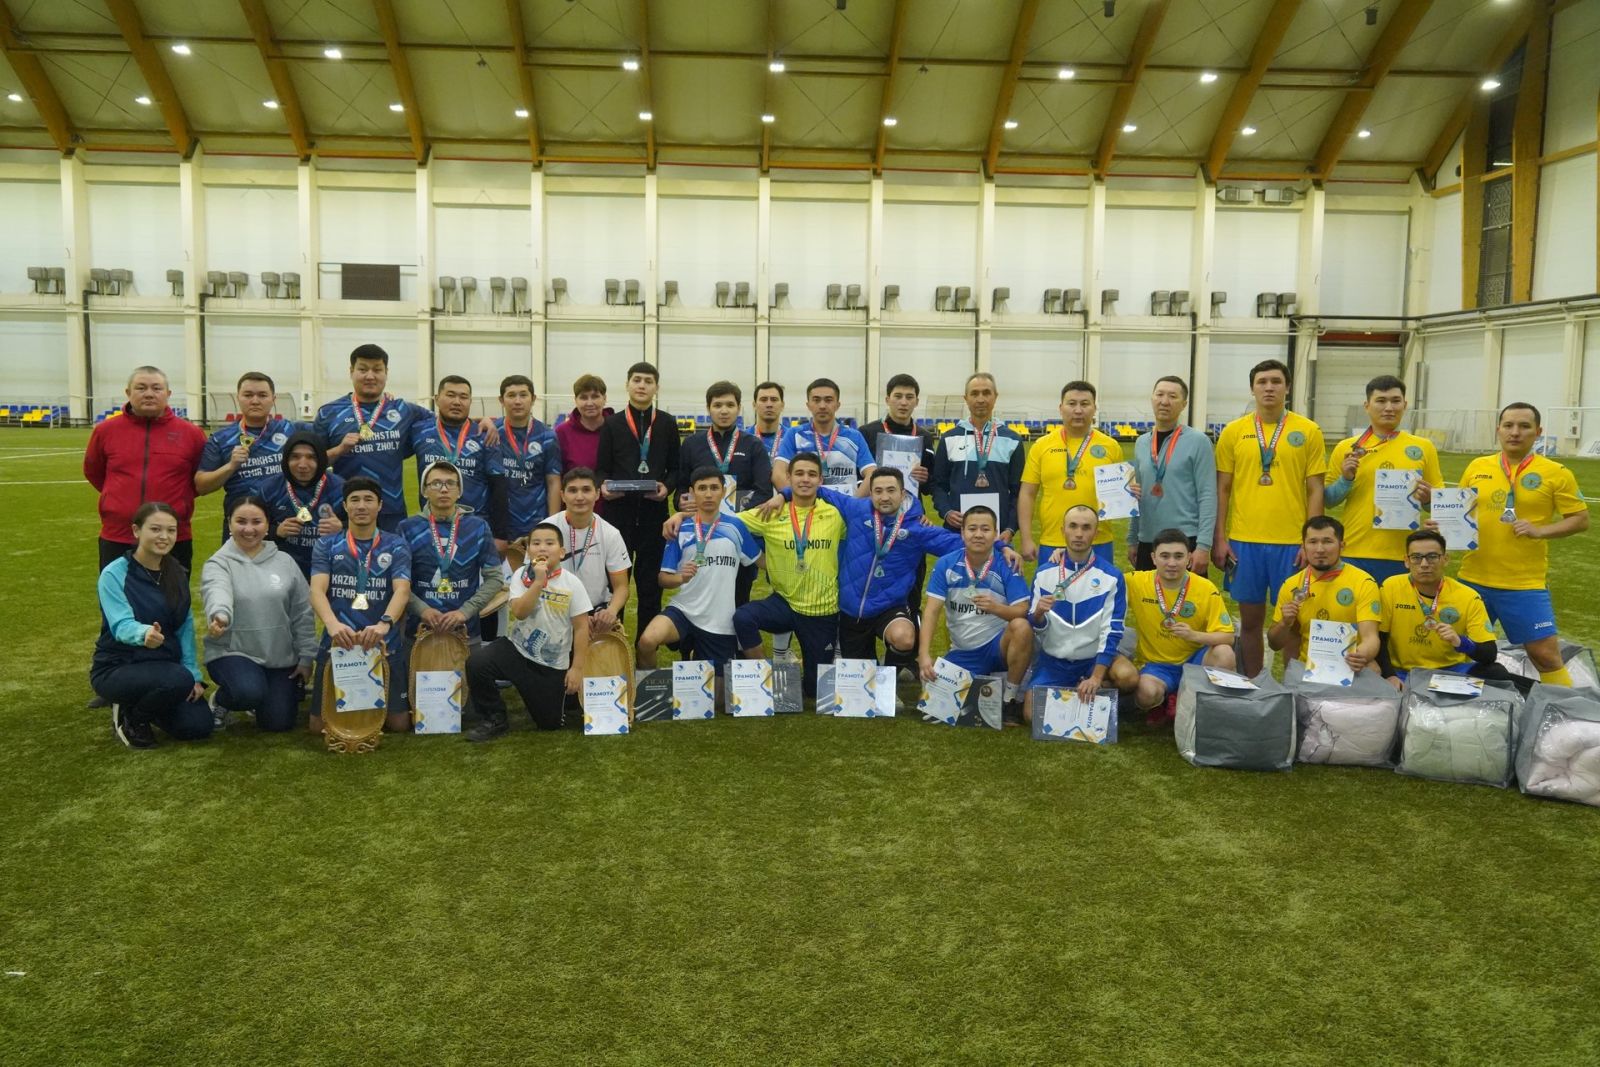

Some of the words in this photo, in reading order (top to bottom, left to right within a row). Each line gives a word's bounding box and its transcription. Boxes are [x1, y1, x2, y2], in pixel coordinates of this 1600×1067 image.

[376, 441, 401, 452] ZHOLY
[784, 539, 832, 550] LOMOTIV
[331, 587, 356, 599] TEMIR
[365, 590, 386, 601] HOLY
[1312, 635, 1343, 644] ГРАМОТА
[335, 661, 368, 669] ГРАМОТА
